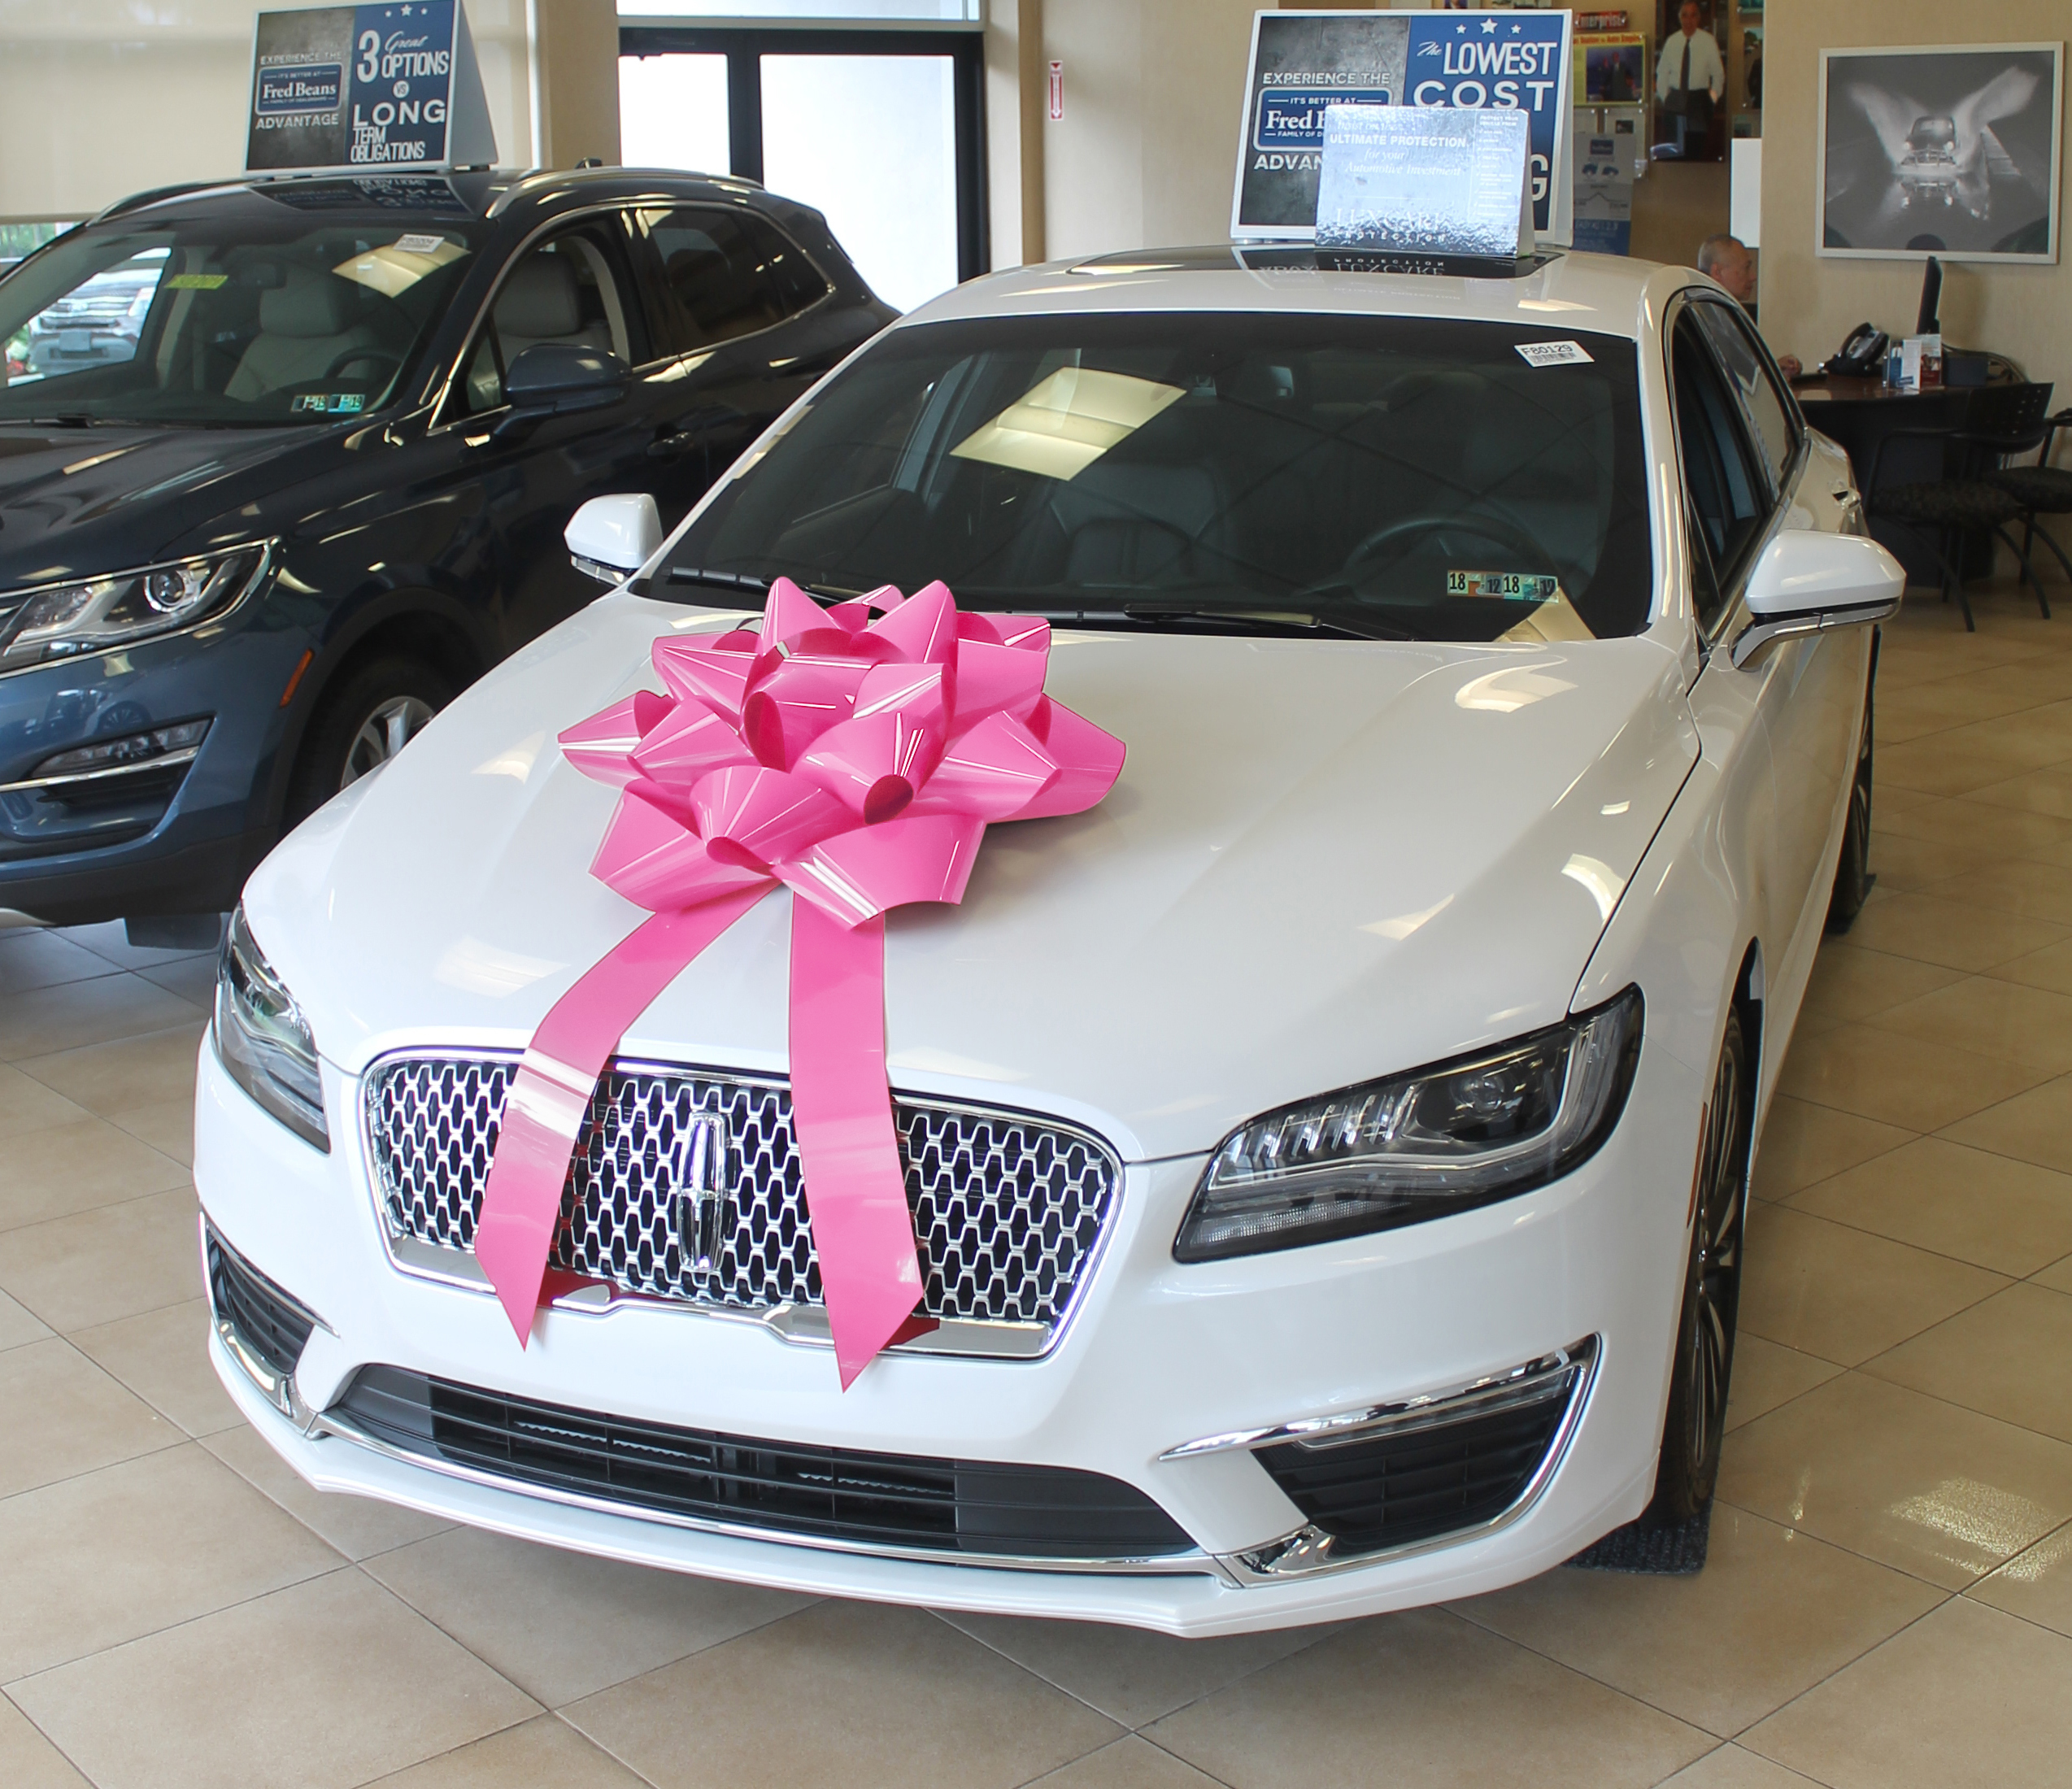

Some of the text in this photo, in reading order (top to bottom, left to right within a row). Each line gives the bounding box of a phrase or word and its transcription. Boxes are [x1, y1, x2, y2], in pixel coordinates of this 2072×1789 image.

[260, 51, 342, 65] EXPERIENCE THE
[357, 29, 429, 83] 3 Great
[381, 50, 450, 79] OPTIONS
[1417, 41, 1557, 75] The LOWEST
[1262, 72, 1390, 85] EXPERIENCE THE
[263, 81, 336, 99] Fred Beans
[1413, 81, 1555, 111] COST
[255, 114, 339, 129] ADVANTAGE
[354, 99, 446, 126] LONG
[1265, 109, 1312, 129] Fred
[353, 126, 386, 145] TERM
[1330, 133, 1386, 145] ULTIMATE
[1391, 136, 1466, 147] PROTECTION
[350, 141, 425, 163] OBLIGATIONS
[1364, 148, 1405, 161] for your
[1345, 162, 1461, 176] Automotive Investment
[1521, 345, 1573, 355] F80129
[1449, 572, 1465, 590] 18
[1487, 578, 1500, 594] 12
[1504, 576, 1520, 594] 18
